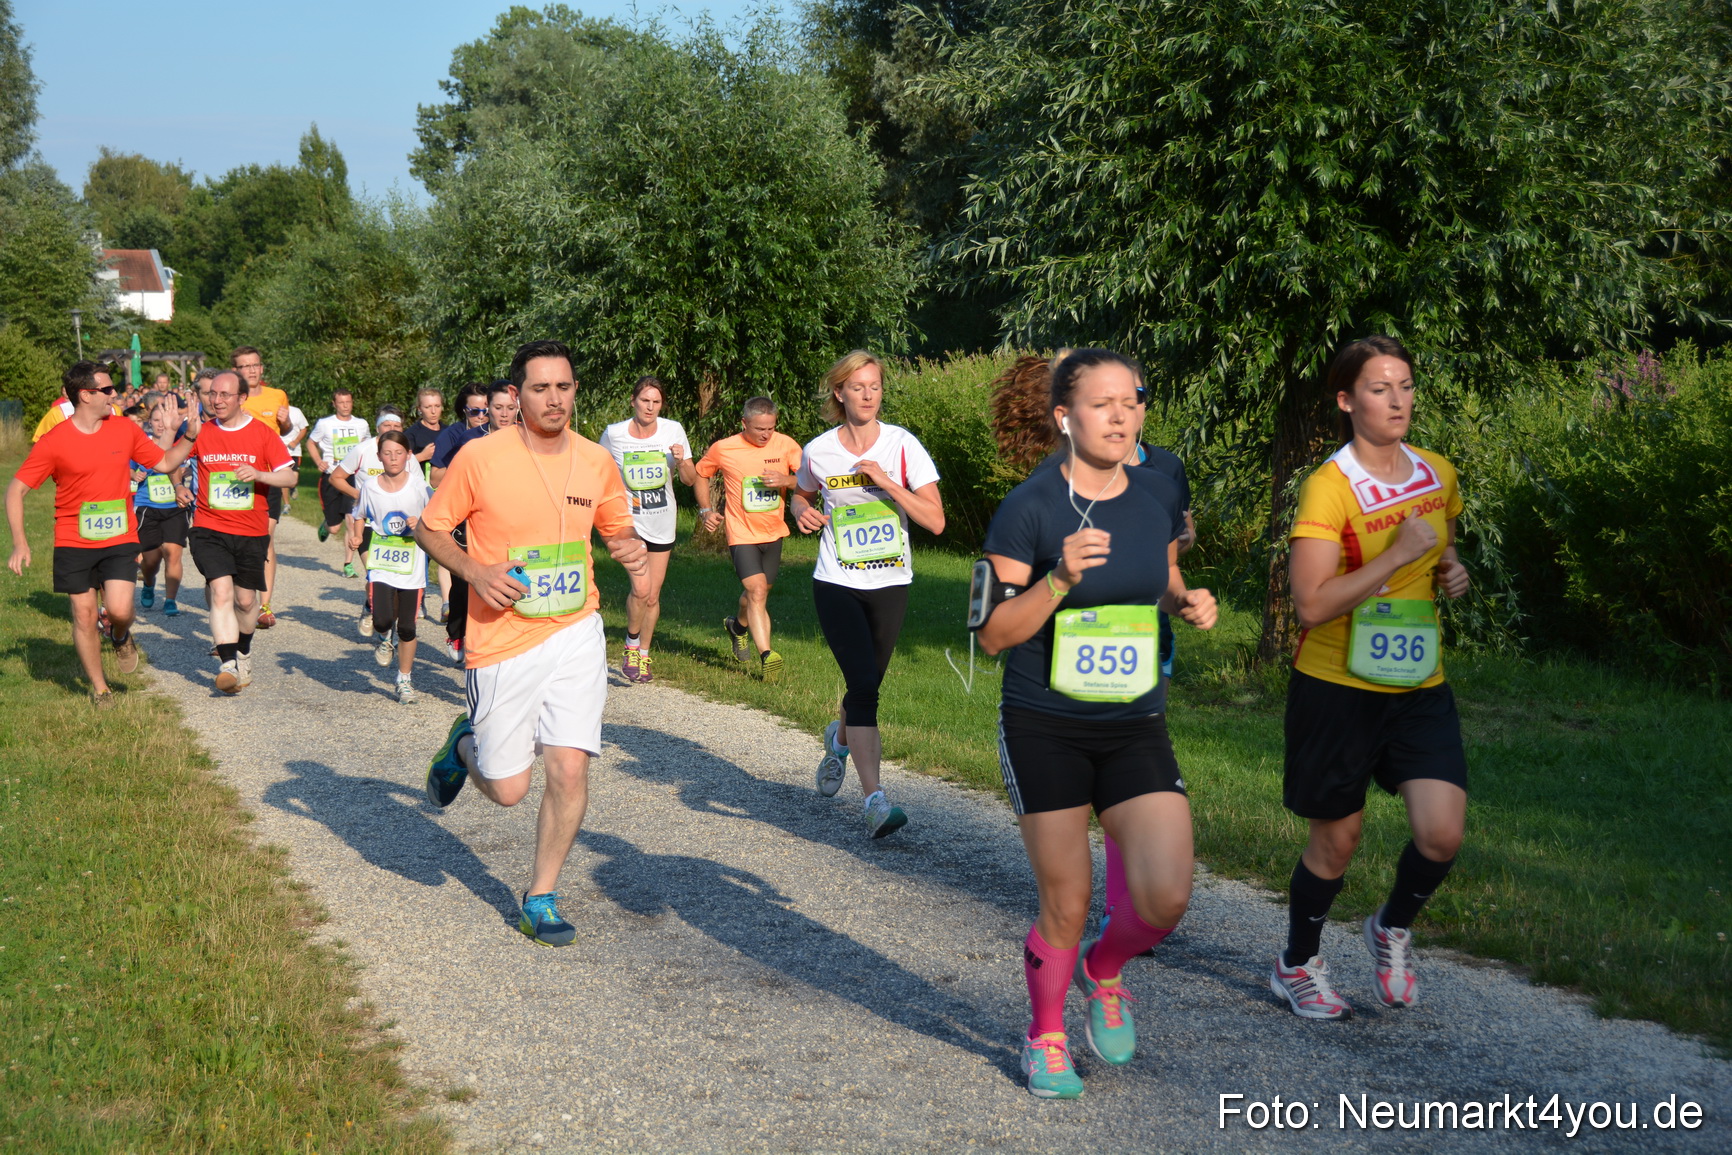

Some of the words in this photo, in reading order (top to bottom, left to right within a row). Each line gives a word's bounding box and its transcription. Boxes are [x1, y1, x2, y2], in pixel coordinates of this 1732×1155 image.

[203, 453, 249, 463] NEUMARKT
[628, 466, 663, 480] 1153
[214, 486, 250, 500] 1404
[644, 491, 661, 504] RW
[747, 489, 779, 503] 1450
[566, 495, 592, 509] THULE
[1364, 509, 1407, 534] MAX
[1411, 495, 1446, 518] BÖGL
[85, 515, 122, 530] 1491
[843, 523, 895, 548] 1029
[374, 548, 410, 564] 1488
[1370, 632, 1425, 663] 936
[1075, 644, 1138, 676] 859
